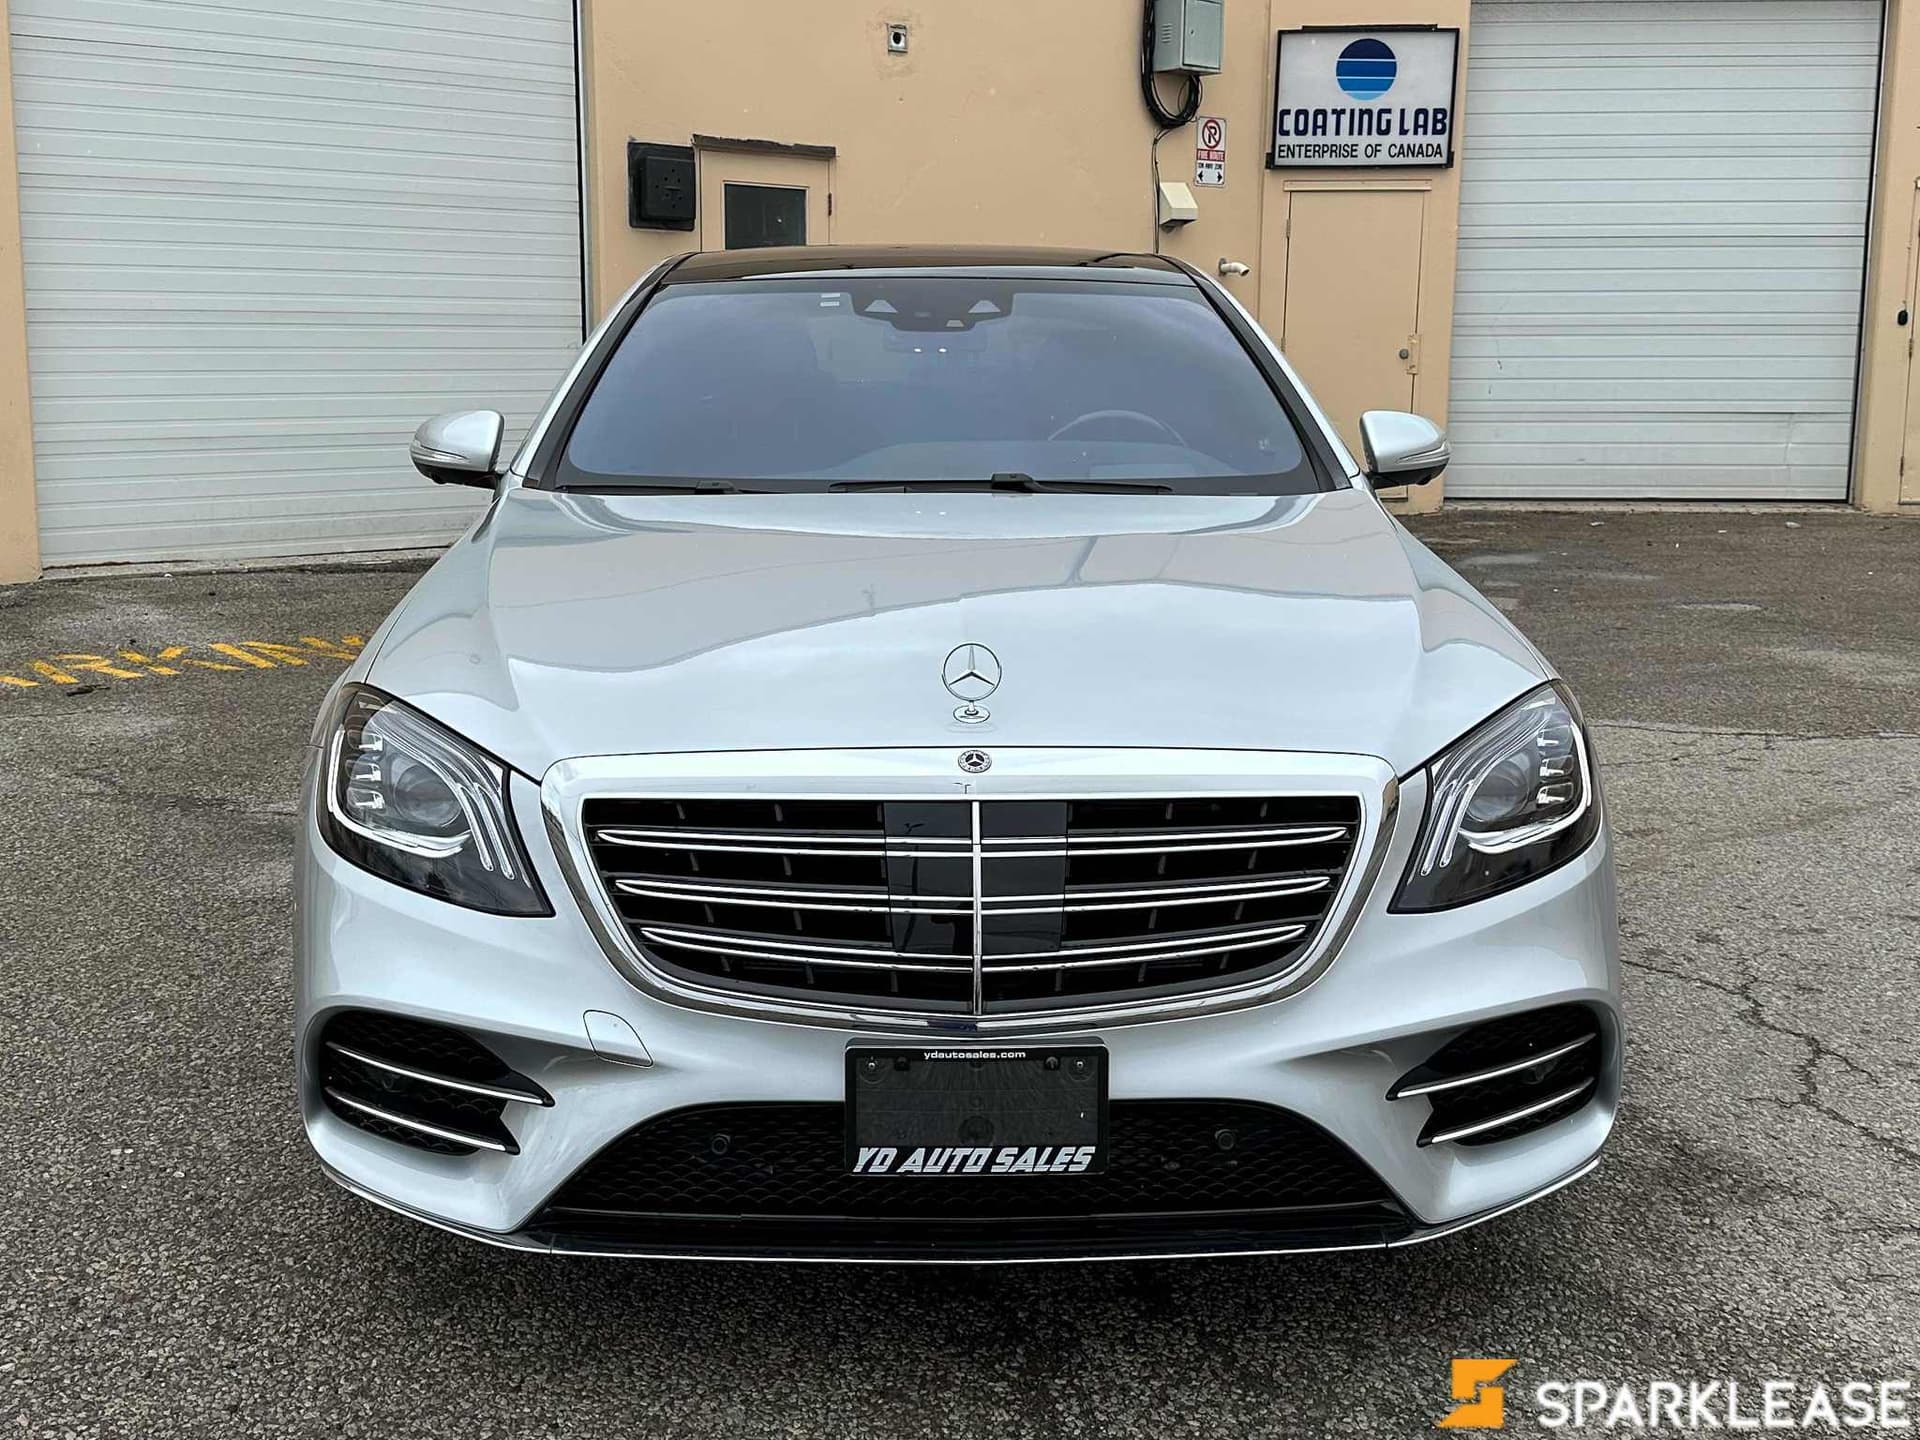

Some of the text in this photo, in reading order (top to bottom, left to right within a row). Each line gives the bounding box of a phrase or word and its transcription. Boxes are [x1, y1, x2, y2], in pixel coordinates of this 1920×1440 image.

[1278, 108, 1448, 136] COATING LAB
[1278, 143, 1442, 159] ENTERPRISE OF CANADA
[923, 1050, 1026, 1060] ydautosales.com
[853, 1146, 1096, 1173] YD AUTO SALES
